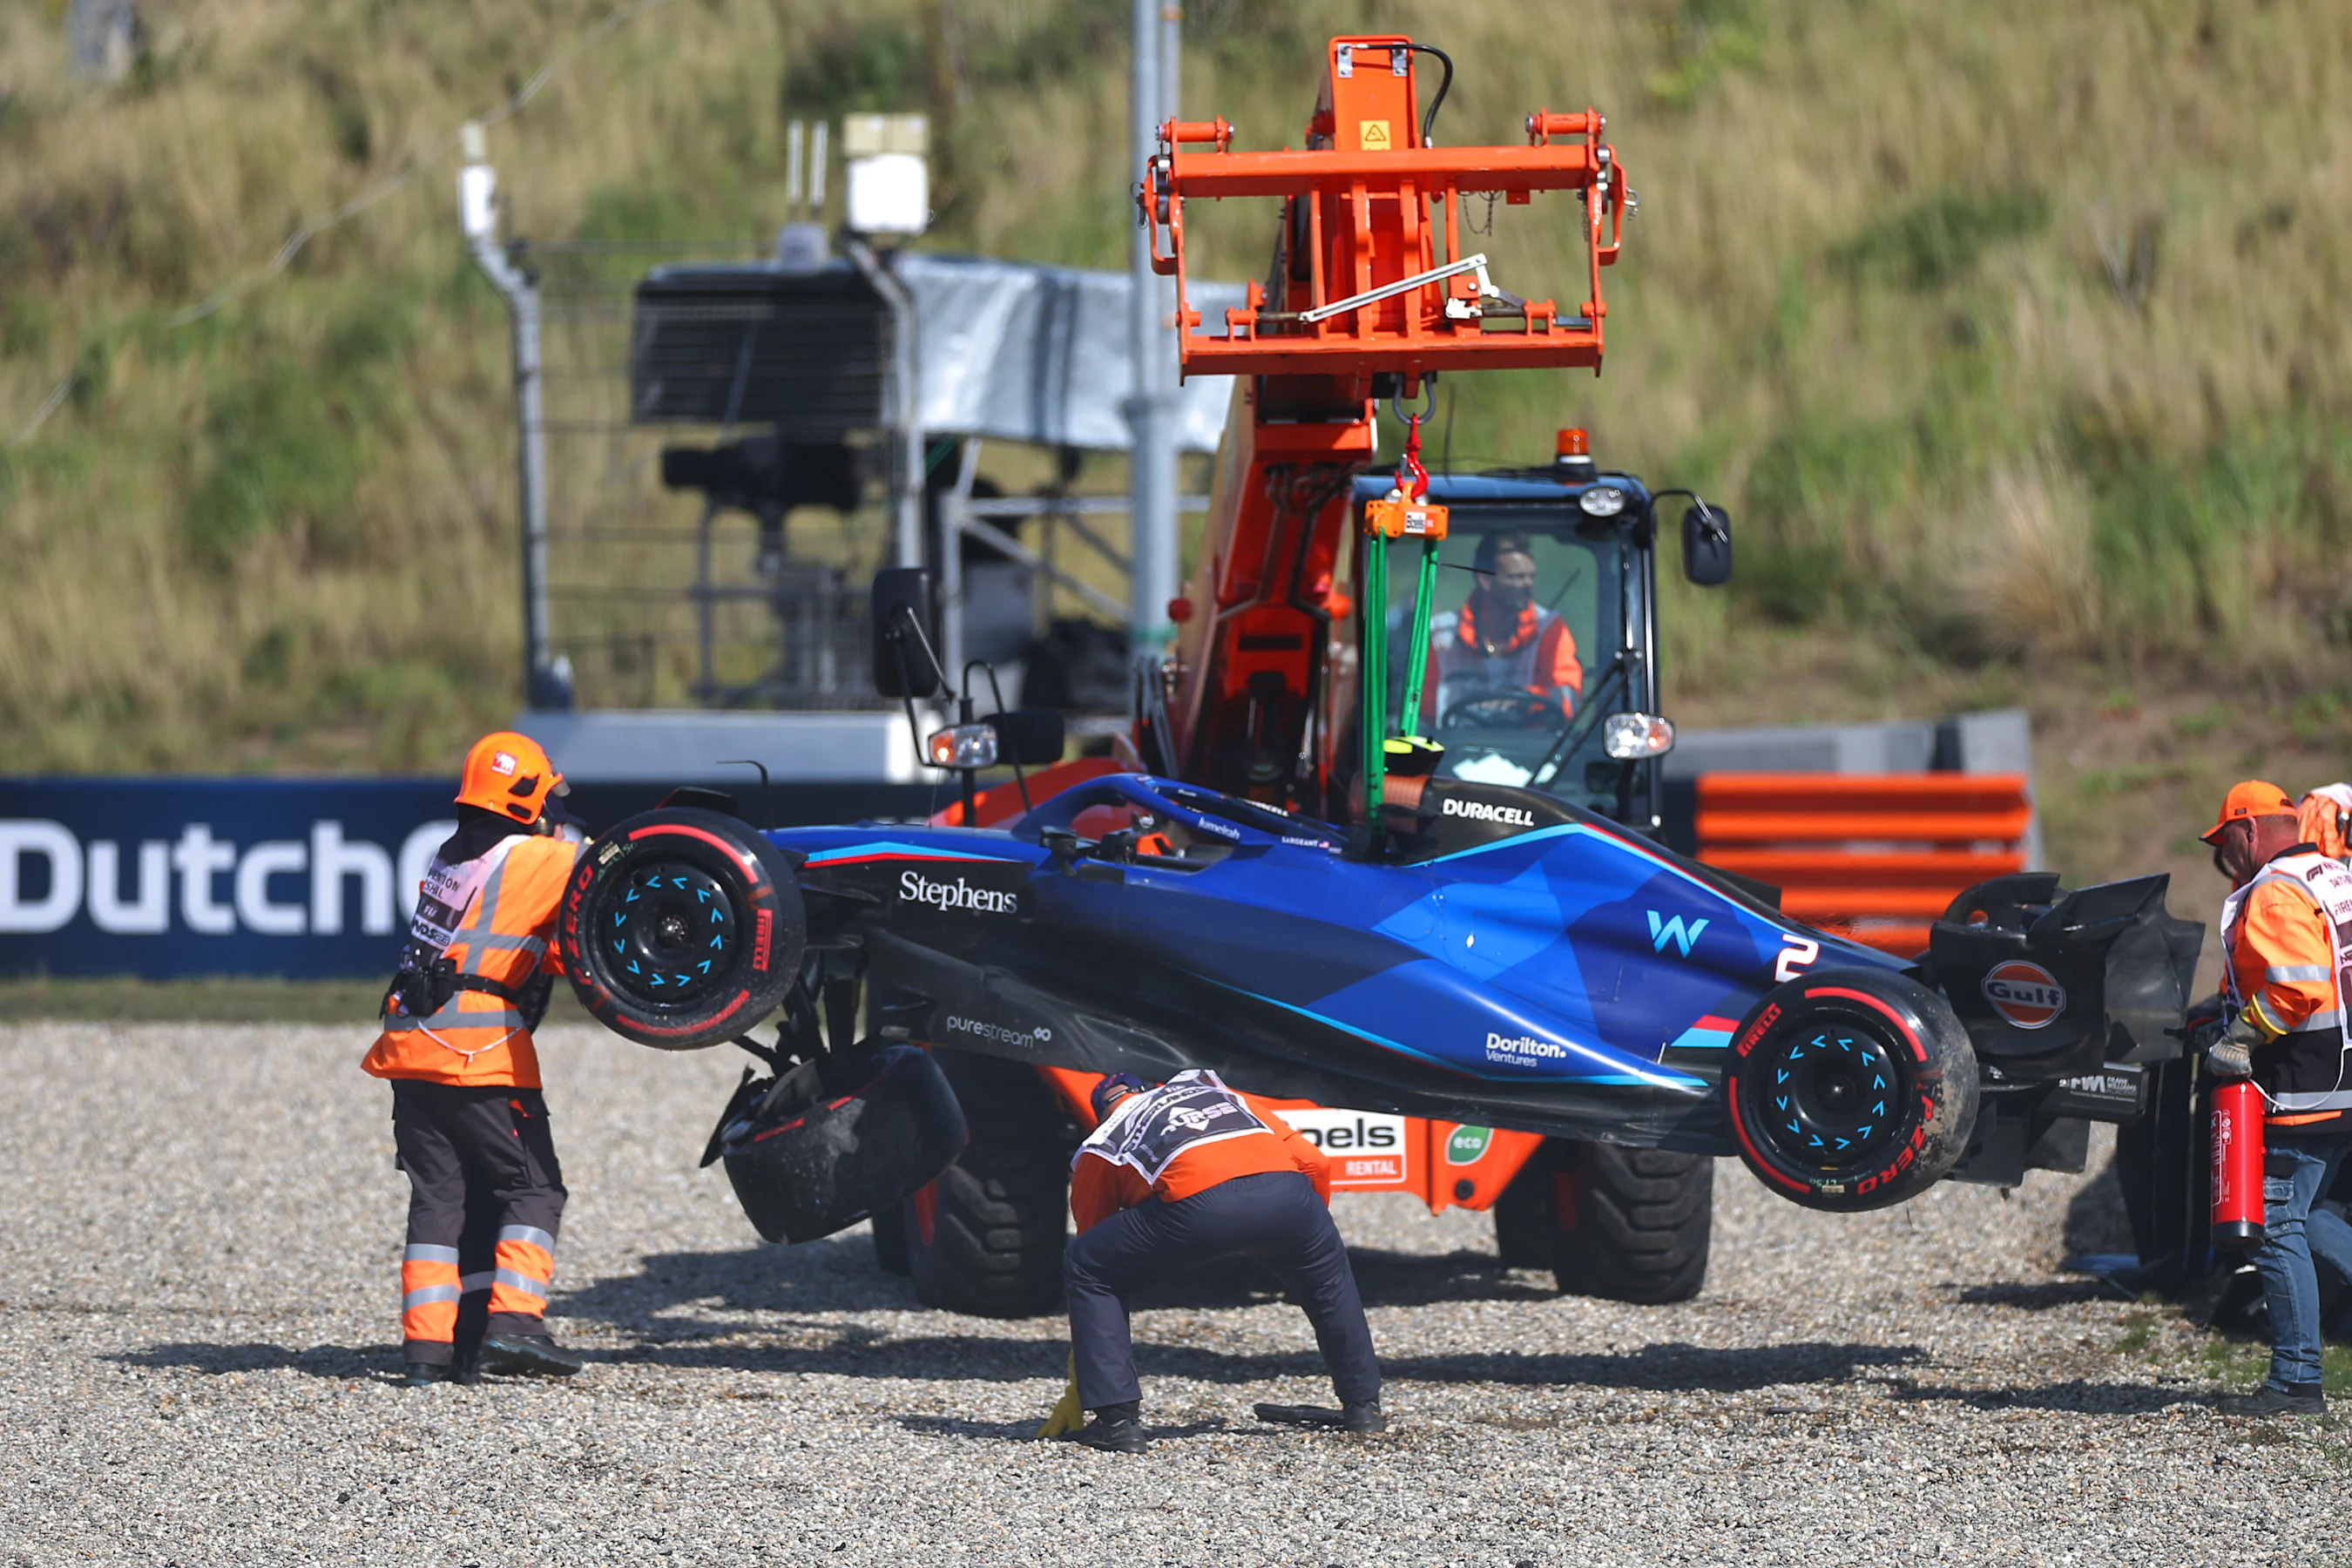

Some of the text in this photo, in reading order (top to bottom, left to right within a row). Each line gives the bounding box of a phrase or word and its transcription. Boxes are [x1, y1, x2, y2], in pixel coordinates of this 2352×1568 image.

[1443, 798, 1535, 827] DURACELL
[899, 870, 1017, 914] Stephens
[564, 864, 594, 959] ZERO
[753, 909, 774, 971] PIRELLI
[1774, 933, 1820, 983] 2
[1987, 982, 2060, 1006] Gulf
[947, 1016, 1034, 1049] purestream
[1736, 1002, 1782, 1058] PIRELLI
[1485, 1049, 1538, 1067] Ventures
[1453, 1136, 1483, 1149] eco
[1857, 1125, 1927, 1195] ZERO
[1345, 1159, 1397, 1176] RENTAL
